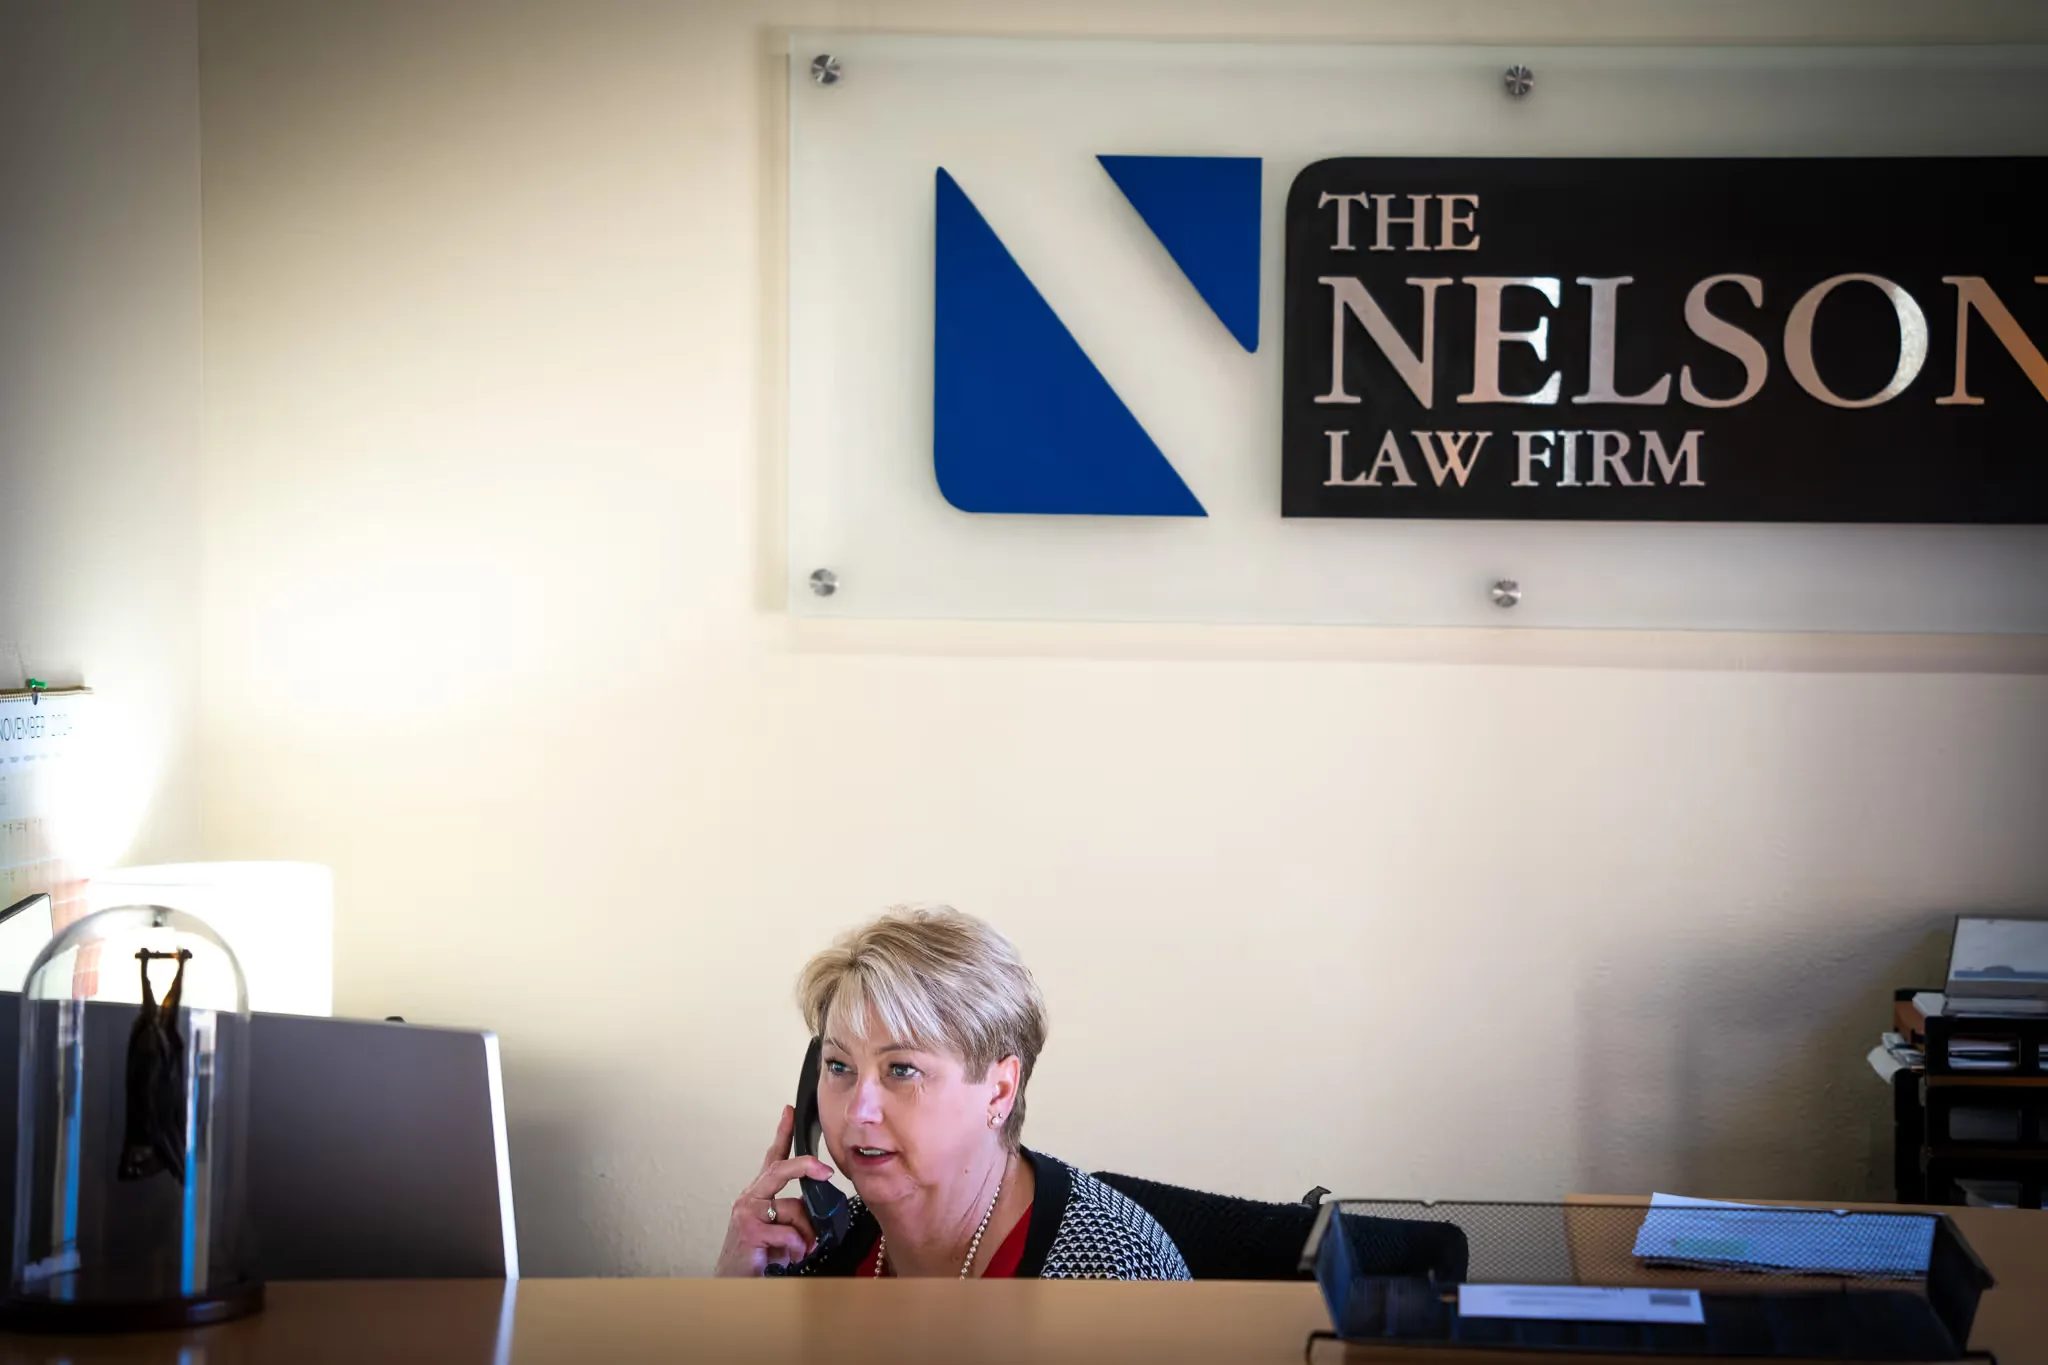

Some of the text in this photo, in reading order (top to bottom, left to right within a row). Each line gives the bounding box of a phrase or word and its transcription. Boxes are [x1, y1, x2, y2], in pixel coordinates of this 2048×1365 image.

[1317, 191, 1481, 251] THE
[1313, 273, 2048, 409] NELSON
[1322, 429, 1706, 488] LAW FIRM
